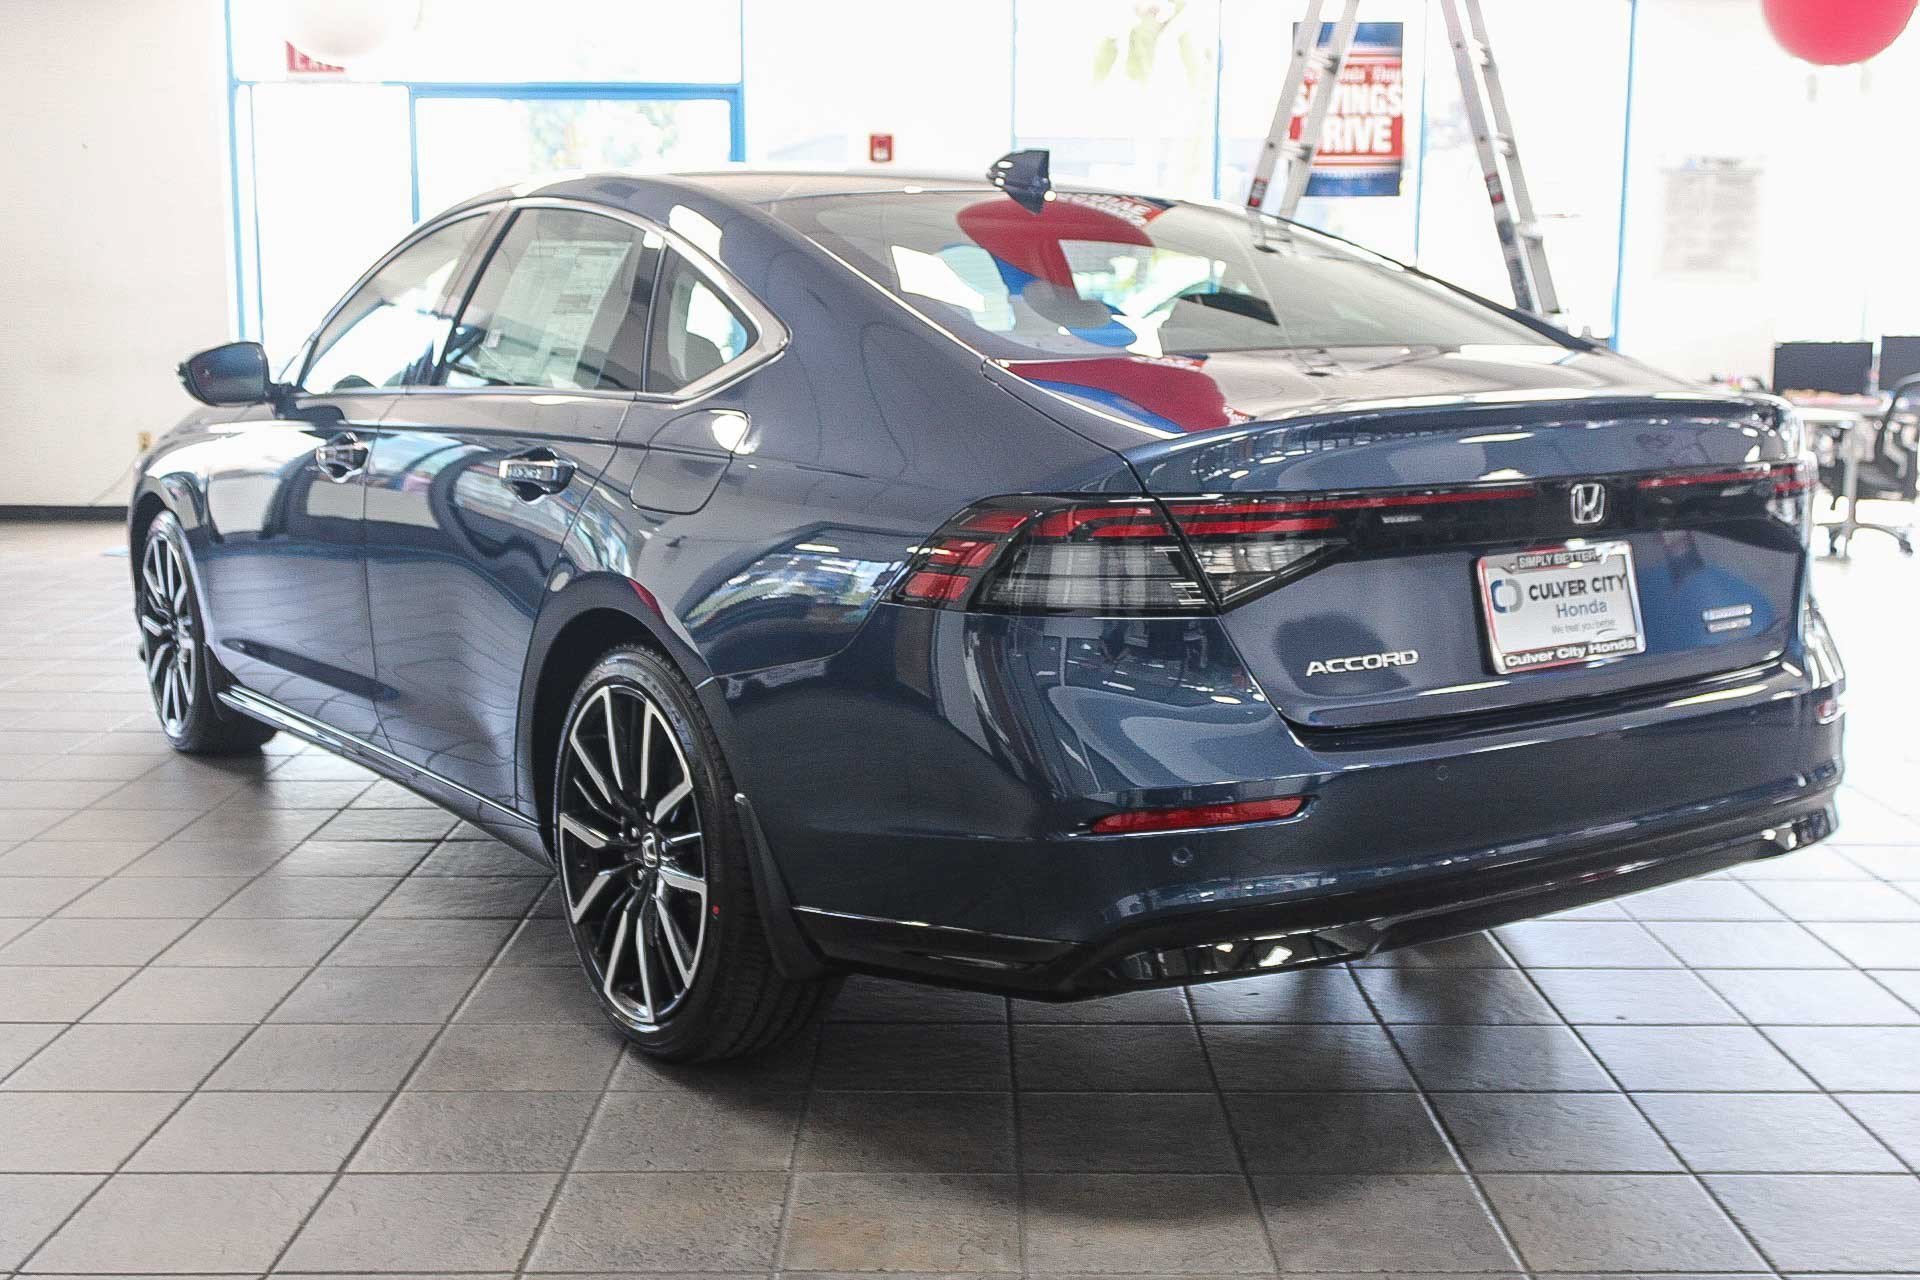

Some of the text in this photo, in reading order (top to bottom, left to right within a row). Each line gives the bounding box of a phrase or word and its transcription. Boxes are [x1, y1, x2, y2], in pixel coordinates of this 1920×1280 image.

[1304, 116, 1392, 151] RIVE
[1529, 573, 1626, 600] CULVER CITY
[1556, 600, 1608, 618] Honda
[1305, 649, 1419, 677] ACCORD
[1505, 638, 1636, 667] Culver City Honda
